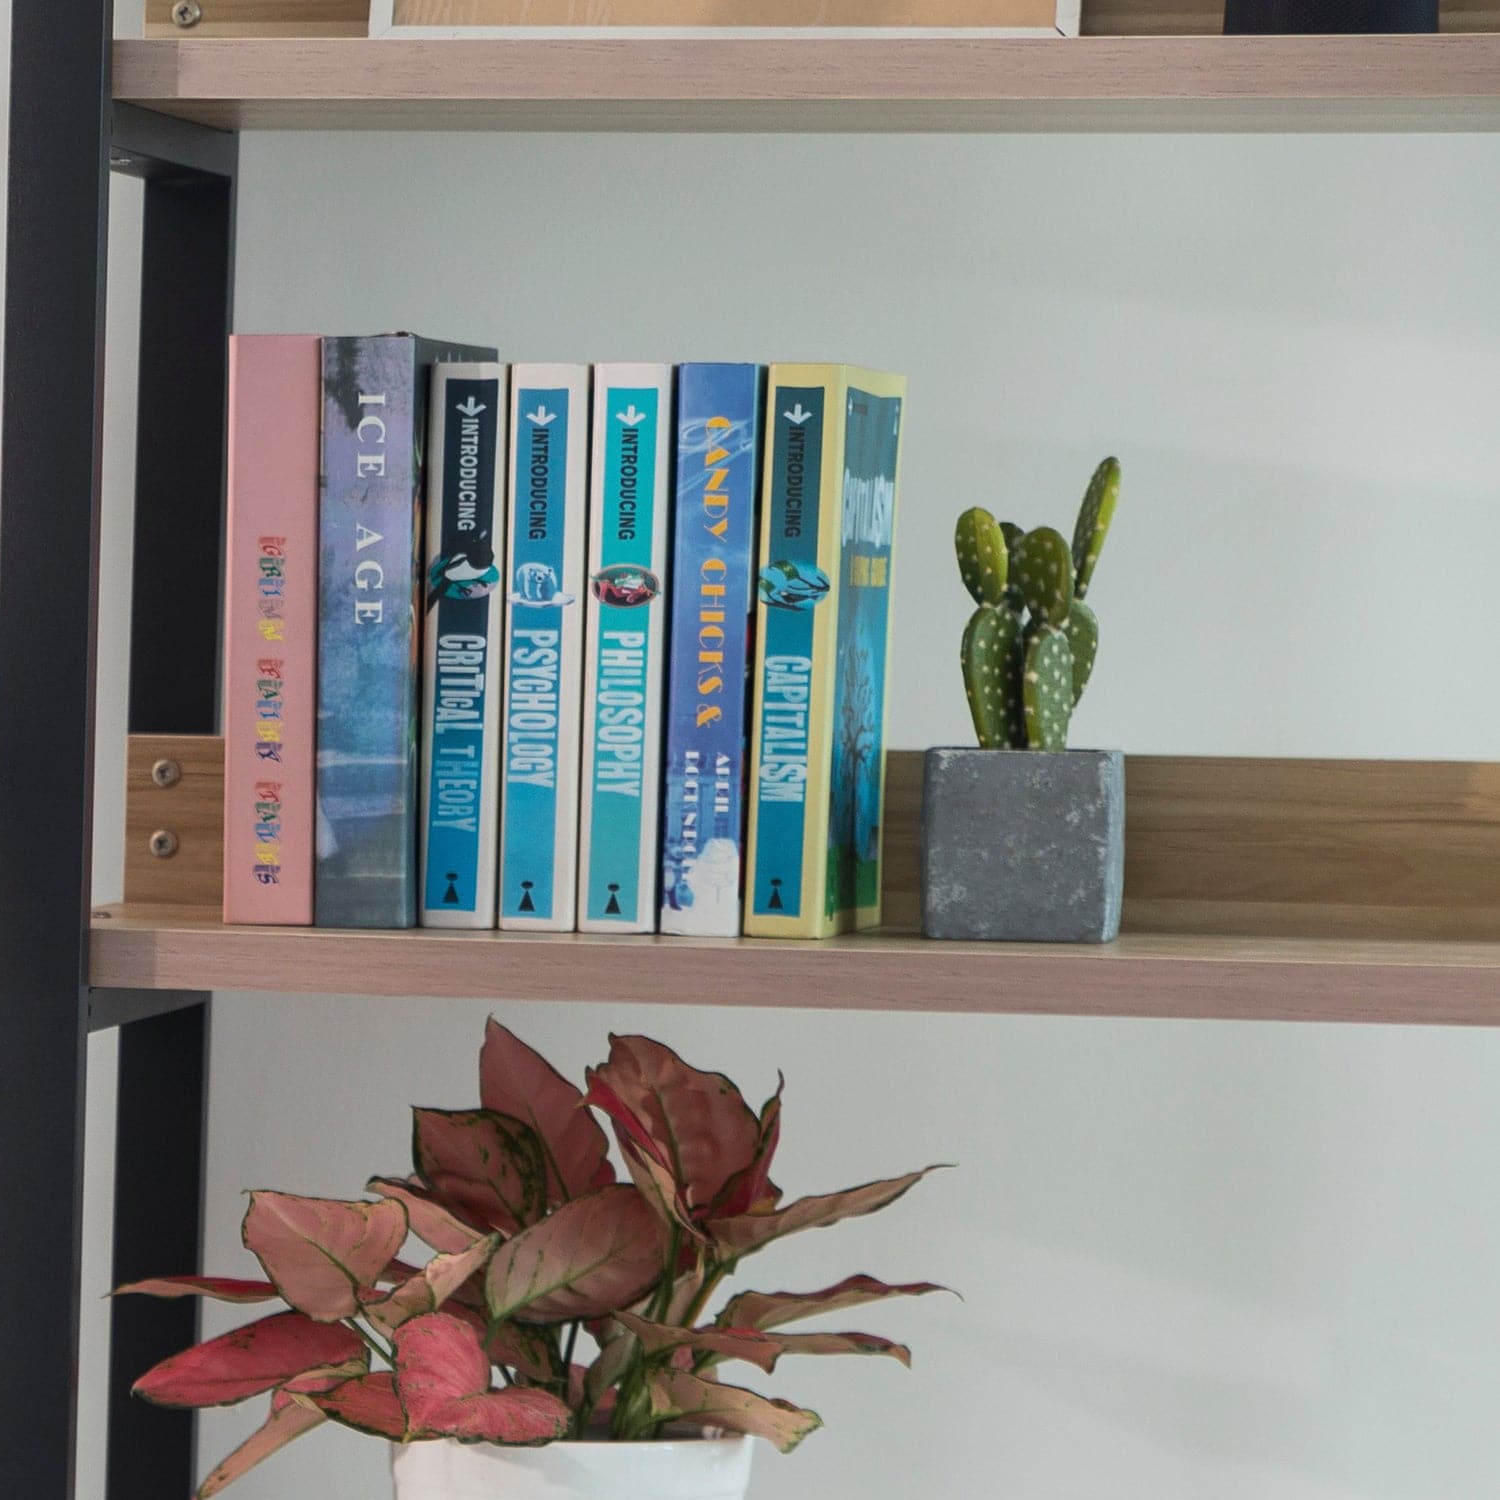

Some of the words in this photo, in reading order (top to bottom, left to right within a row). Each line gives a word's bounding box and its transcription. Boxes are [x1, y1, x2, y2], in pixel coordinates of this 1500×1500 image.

[356, 392, 387, 479] ICE
[457, 417, 480, 531] INTRODUCING
[527, 427, 551, 540] INTRODUCING
[617, 427, 640, 541] INTRODUCING
[702, 415, 733, 543] CANDY
[783, 425, 807, 539] INTRODUCING
[256, 535, 287, 642] GRIMM
[354, 522, 385, 627] AGE
[696, 558, 728, 695] CHICKS
[254, 658, 285, 763] FAIRY
[435, 633, 487, 732] CRITICAL
[508, 628, 559, 788] PSYCHOLOGY
[595, 630, 646, 796] PHILOSOPHY
[695, 703, 723, 728] &
[759, 654, 813, 803] CAPITALISM
[253, 781, 284, 886] TALES
[433, 744, 478, 832] THEORY
